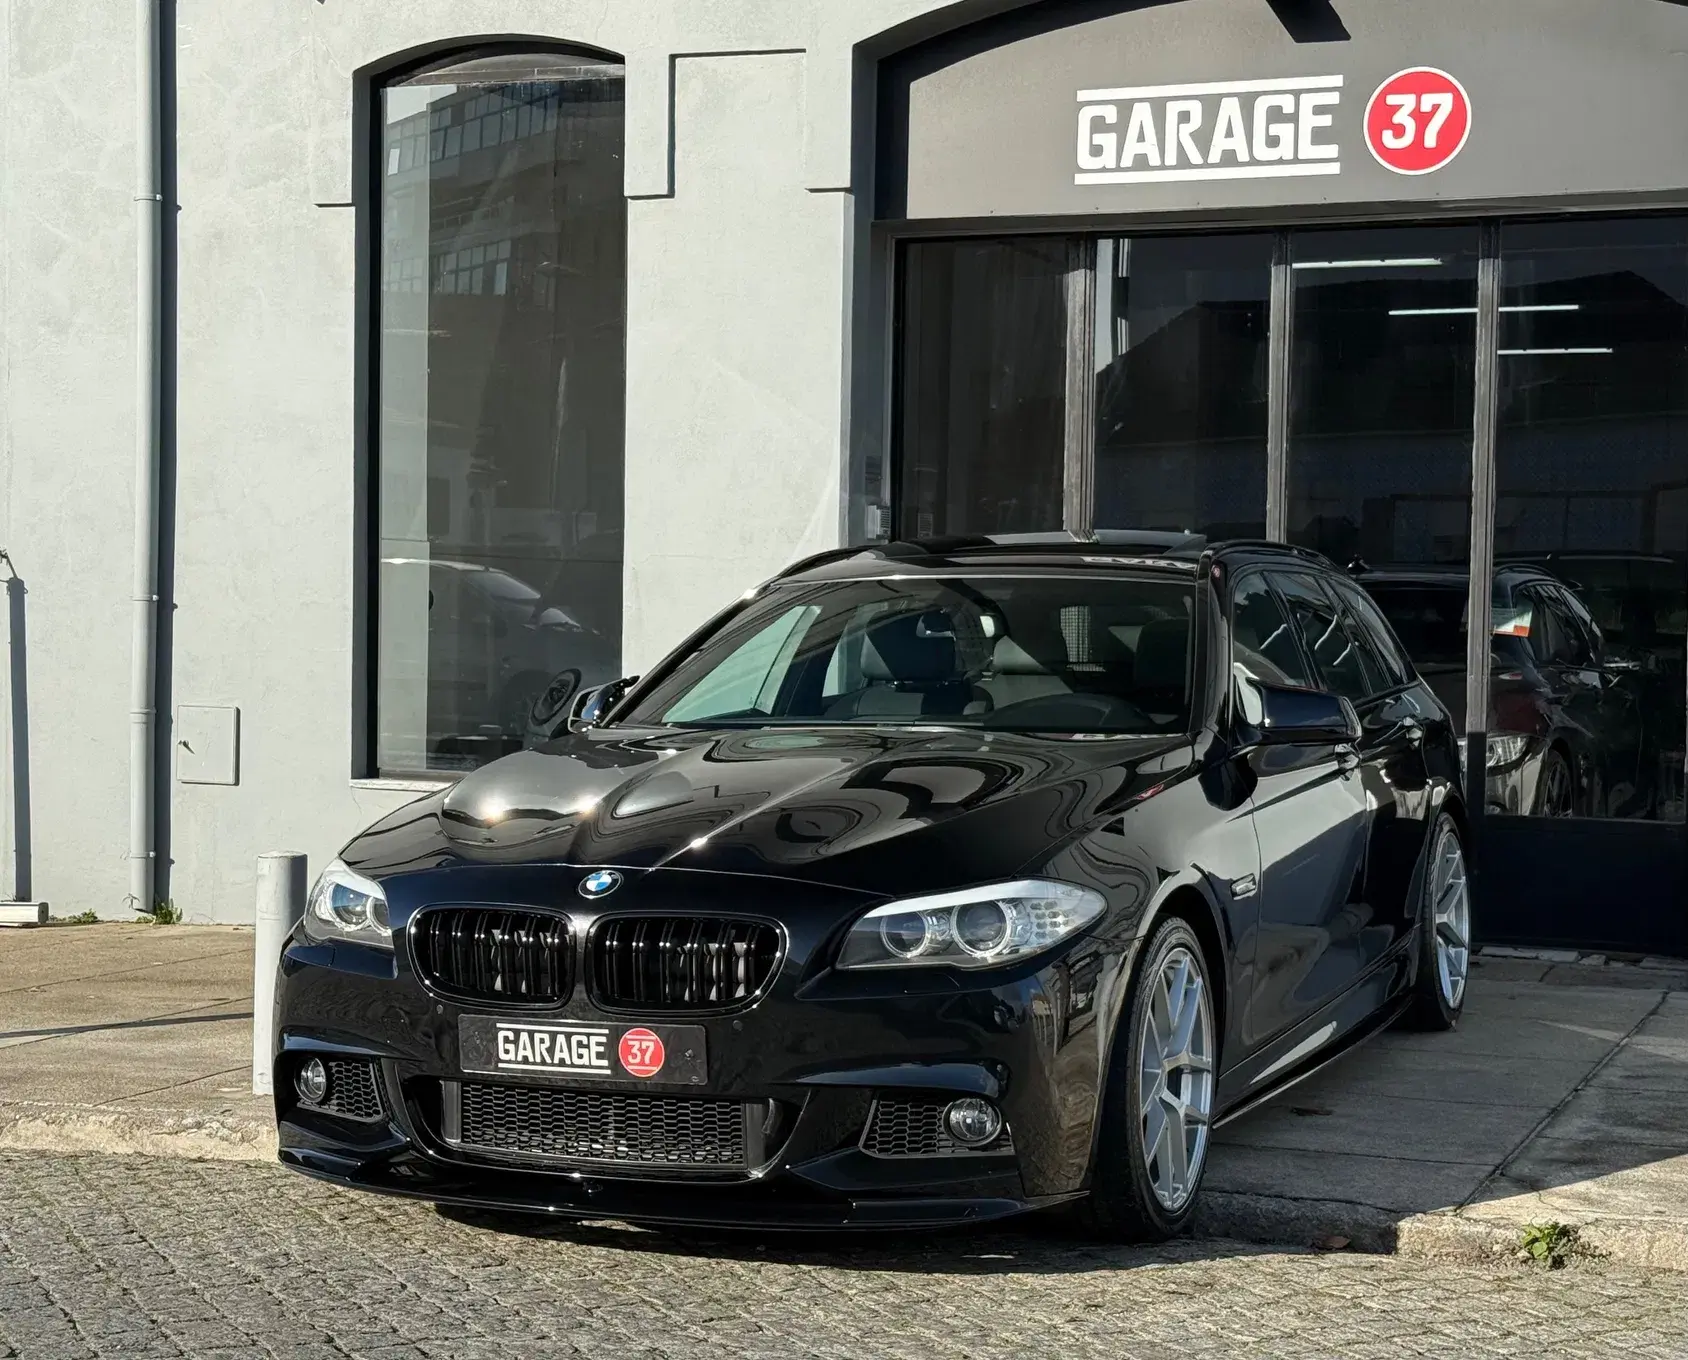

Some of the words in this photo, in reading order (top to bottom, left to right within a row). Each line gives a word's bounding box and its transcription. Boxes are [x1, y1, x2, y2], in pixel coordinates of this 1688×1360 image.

[1077, 91, 1340, 170] GARAGE
[1381, 92, 1453, 149] 37
[497, 1030, 609, 1066] GARAGE
[627, 1040, 655, 1064] 37
